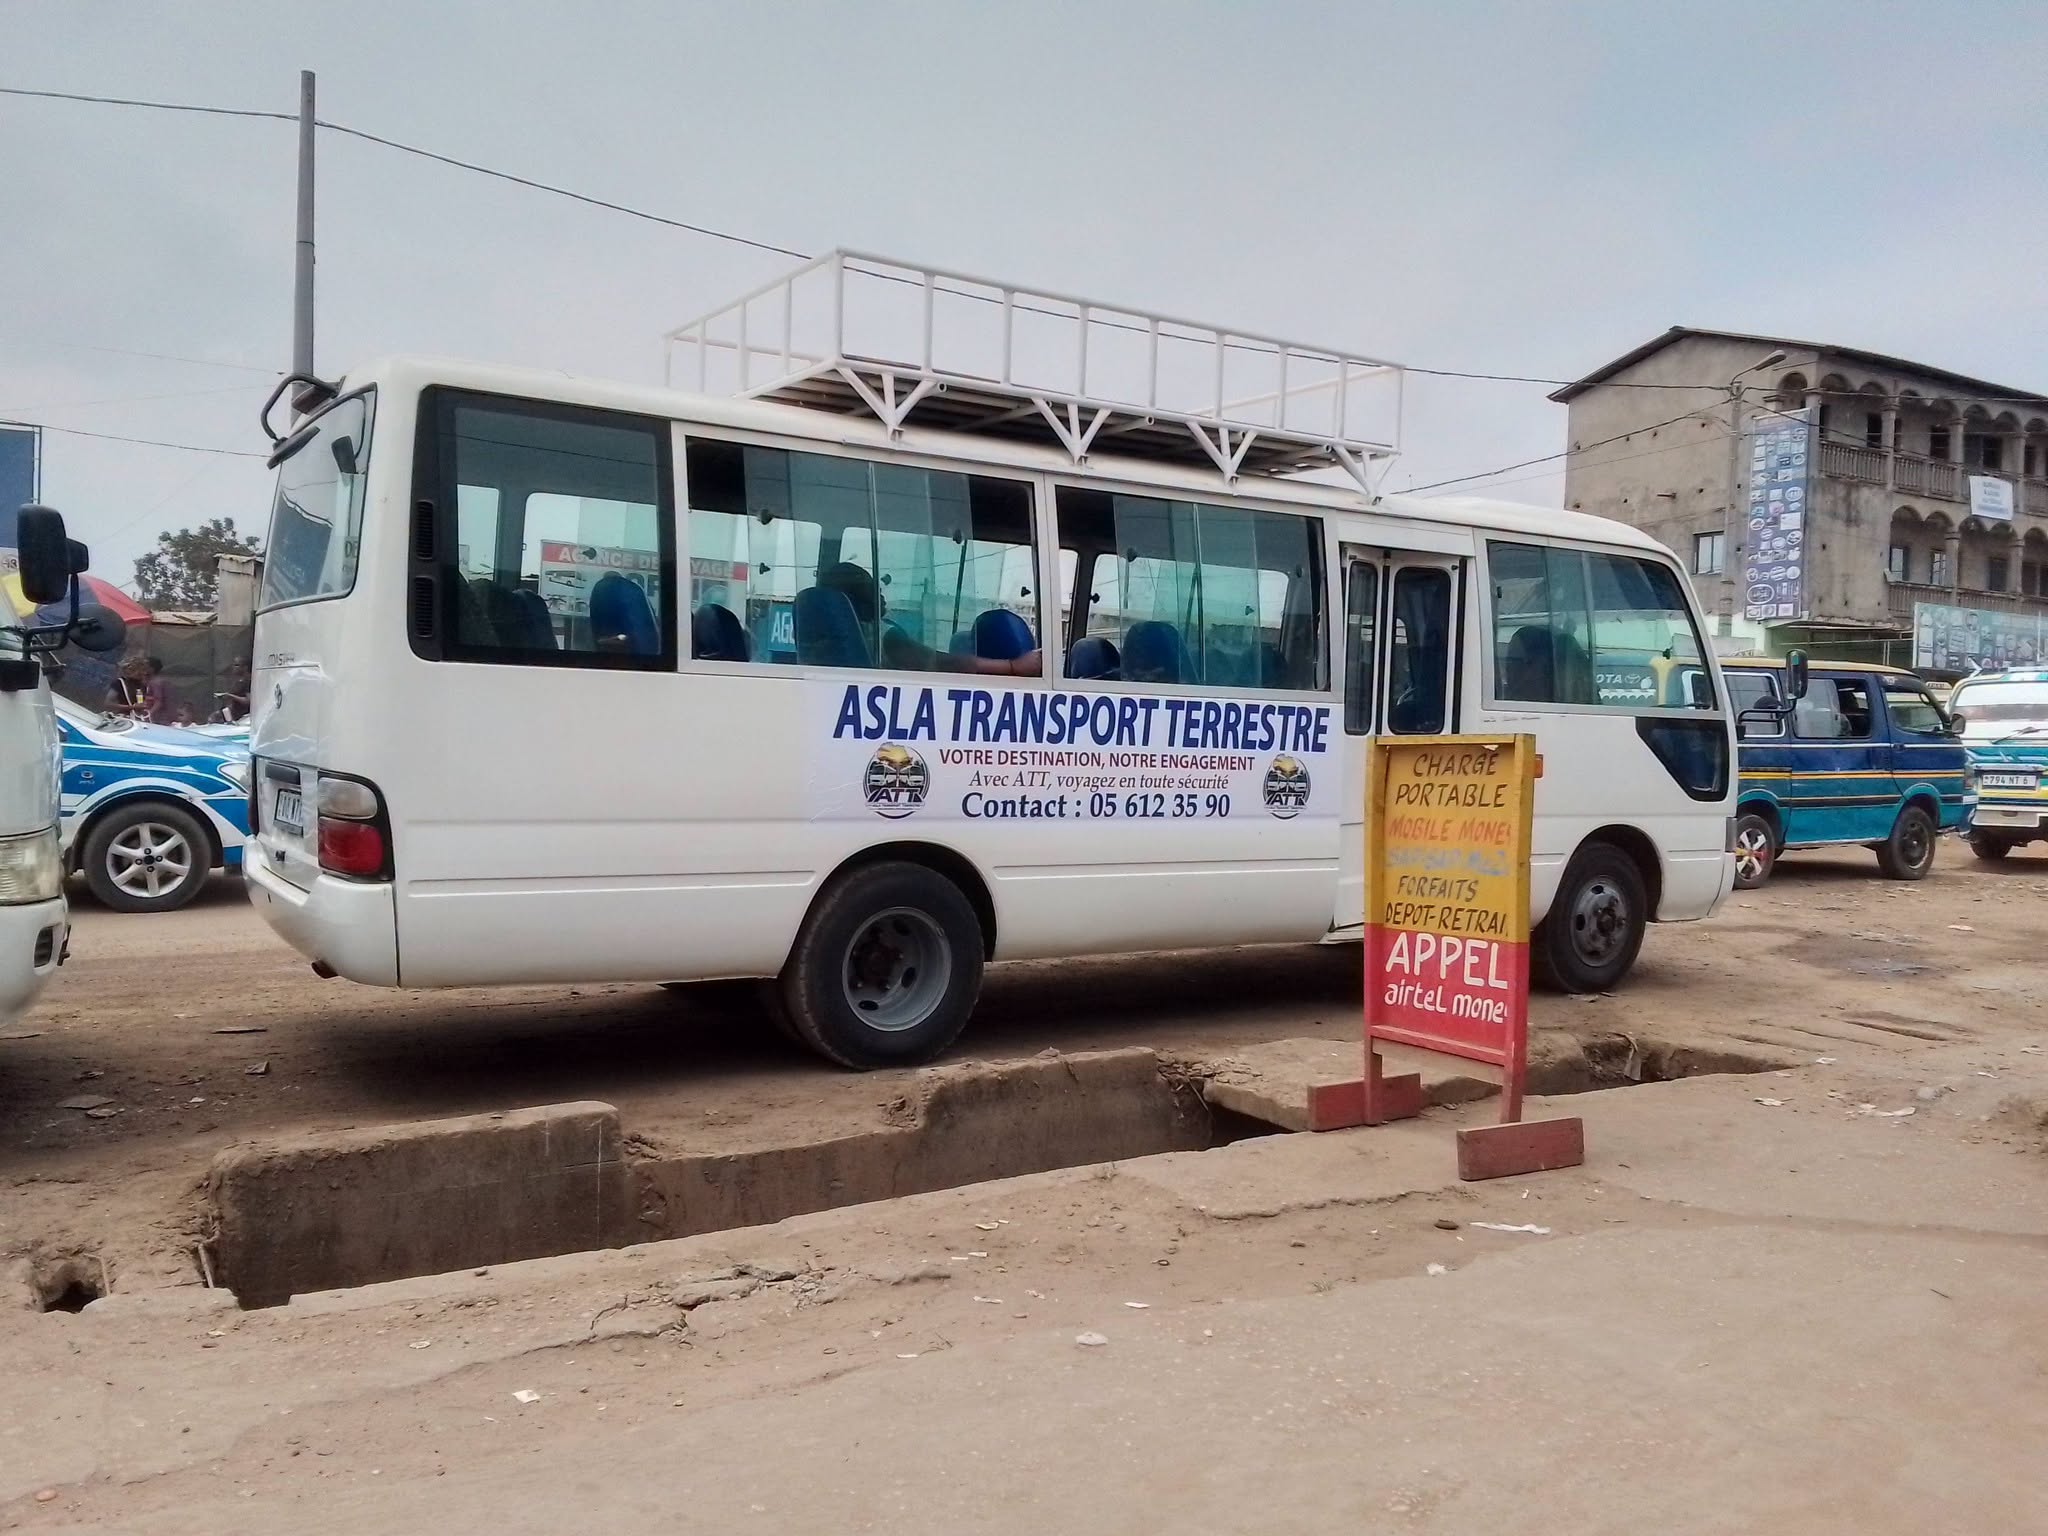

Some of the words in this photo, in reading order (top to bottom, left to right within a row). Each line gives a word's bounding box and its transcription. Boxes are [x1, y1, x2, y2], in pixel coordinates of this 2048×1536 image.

[558, 547, 633, 568] AGNCE
[771, 611, 796, 644] AG
[833, 684, 936, 741] ASLA
[948, 690, 1159, 747] TRANSPORT
[1166, 700, 1330, 752] TERRESTRE
[940, 749, 993, 765] VOTRE
[998, 750, 1105, 770] DESTINATION,
[1109, 753, 1157, 768] NOTRE
[1161, 754, 1255, 770] ENGAGEMENT
[1413, 752, 1498, 777] CHARGE
[968, 770, 1008, 787] Avec
[1013, 771, 1052, 790] ATT,
[1057, 775, 1115, 792] voyagez
[1119, 777, 1136, 788] en
[1140, 774, 1174, 789] toute
[1178, 774, 1229, 789] sécurité
[868, 788, 923, 802] ATT
[962, 792, 1067, 818] Contact
[1090, 793, 1117, 818] 05
[1125, 793, 1165, 818] 612
[1172, 794, 1198, 818] 35
[1205, 794, 1231, 818] 90
[1395, 782, 1508, 807] PORTABLE
[1397, 875, 1479, 902] FORFAITS
[1385, 902, 1509, 936] DEPOT-RETRAI
[1385, 932, 1508, 989] APPEL
[1384, 979, 1447, 1012] airtel
